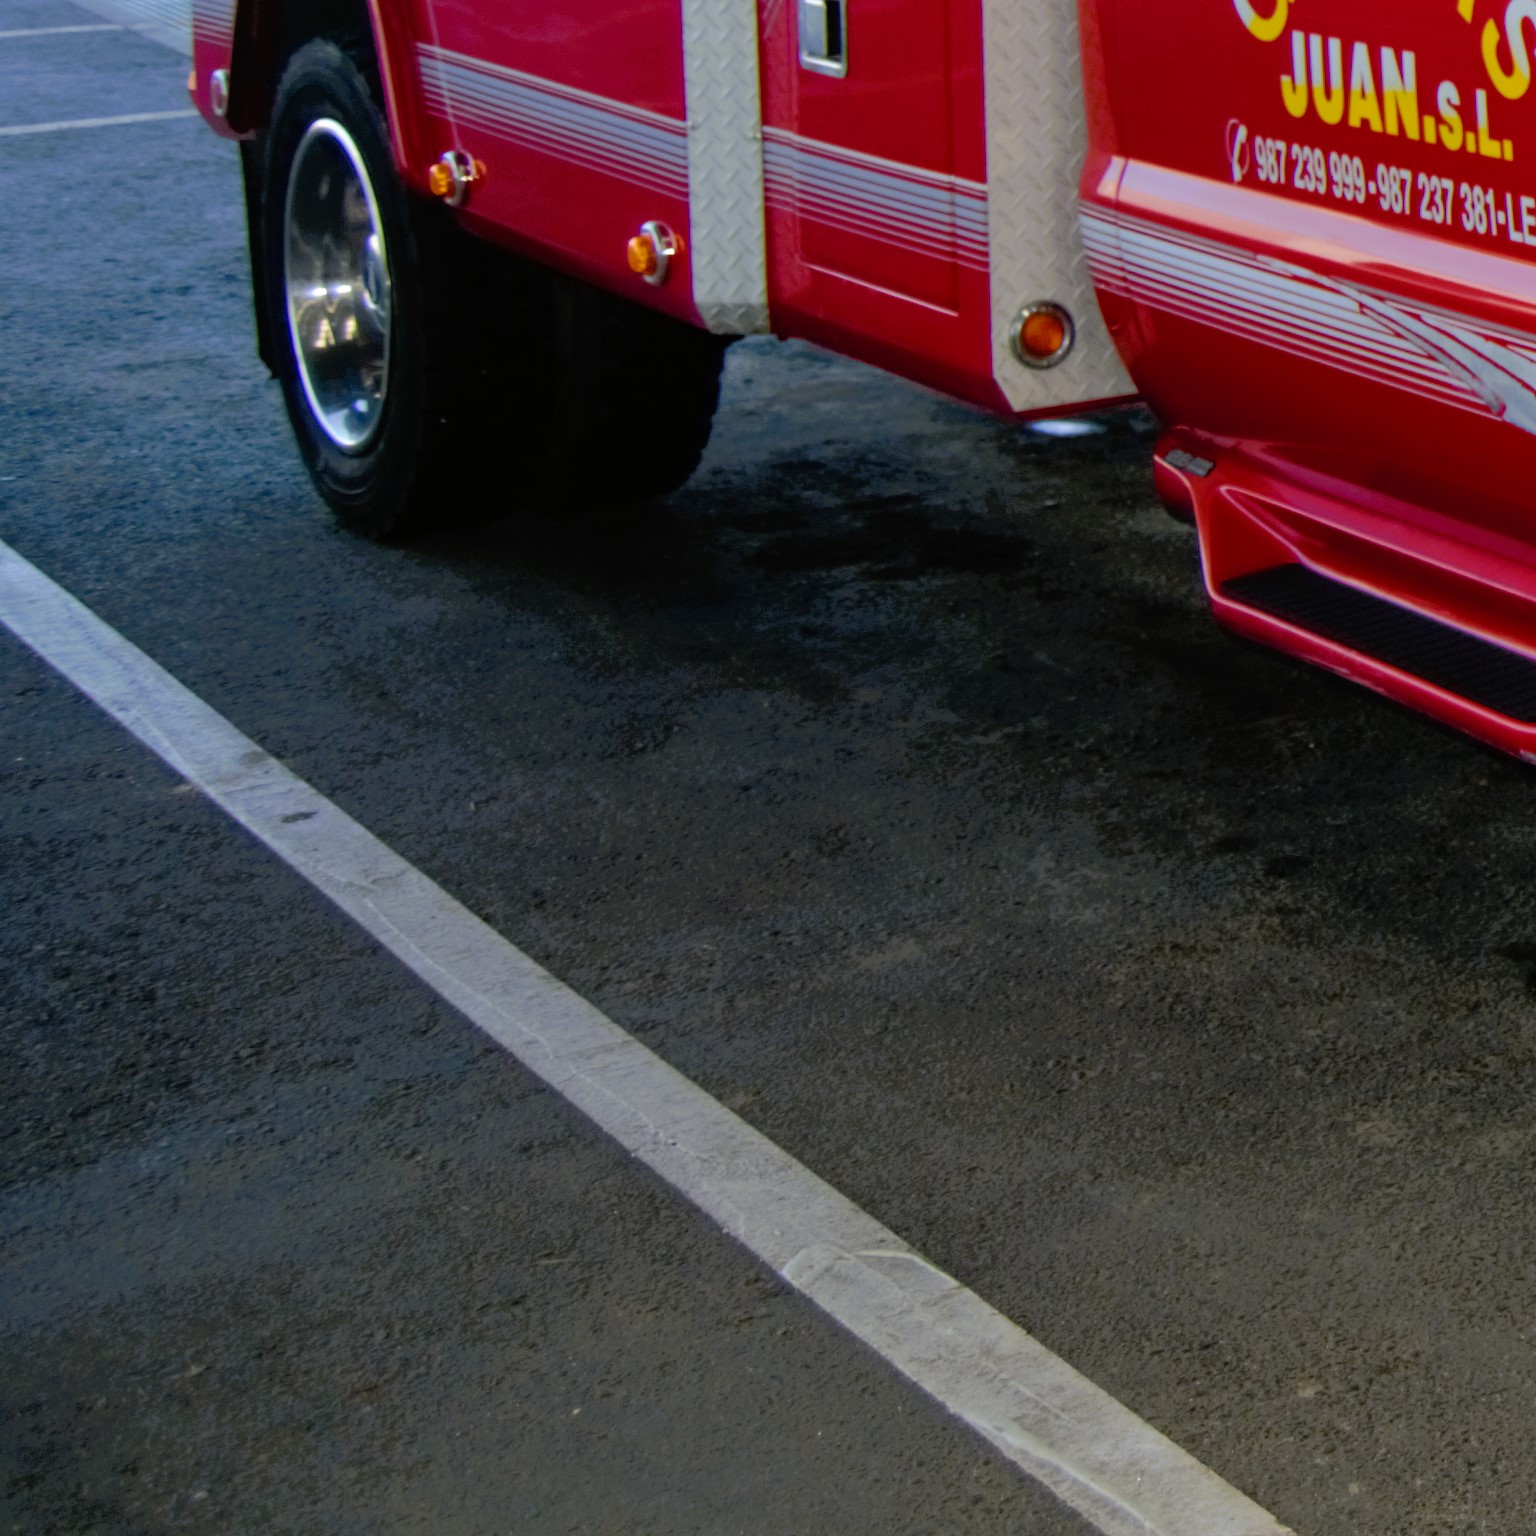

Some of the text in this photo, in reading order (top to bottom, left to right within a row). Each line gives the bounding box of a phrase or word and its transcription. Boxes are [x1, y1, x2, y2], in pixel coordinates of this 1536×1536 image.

[1254, 136, 1286, 184] 987
[1291, 144, 1326, 194] 239
[1417, 172, 1453, 225] 237
